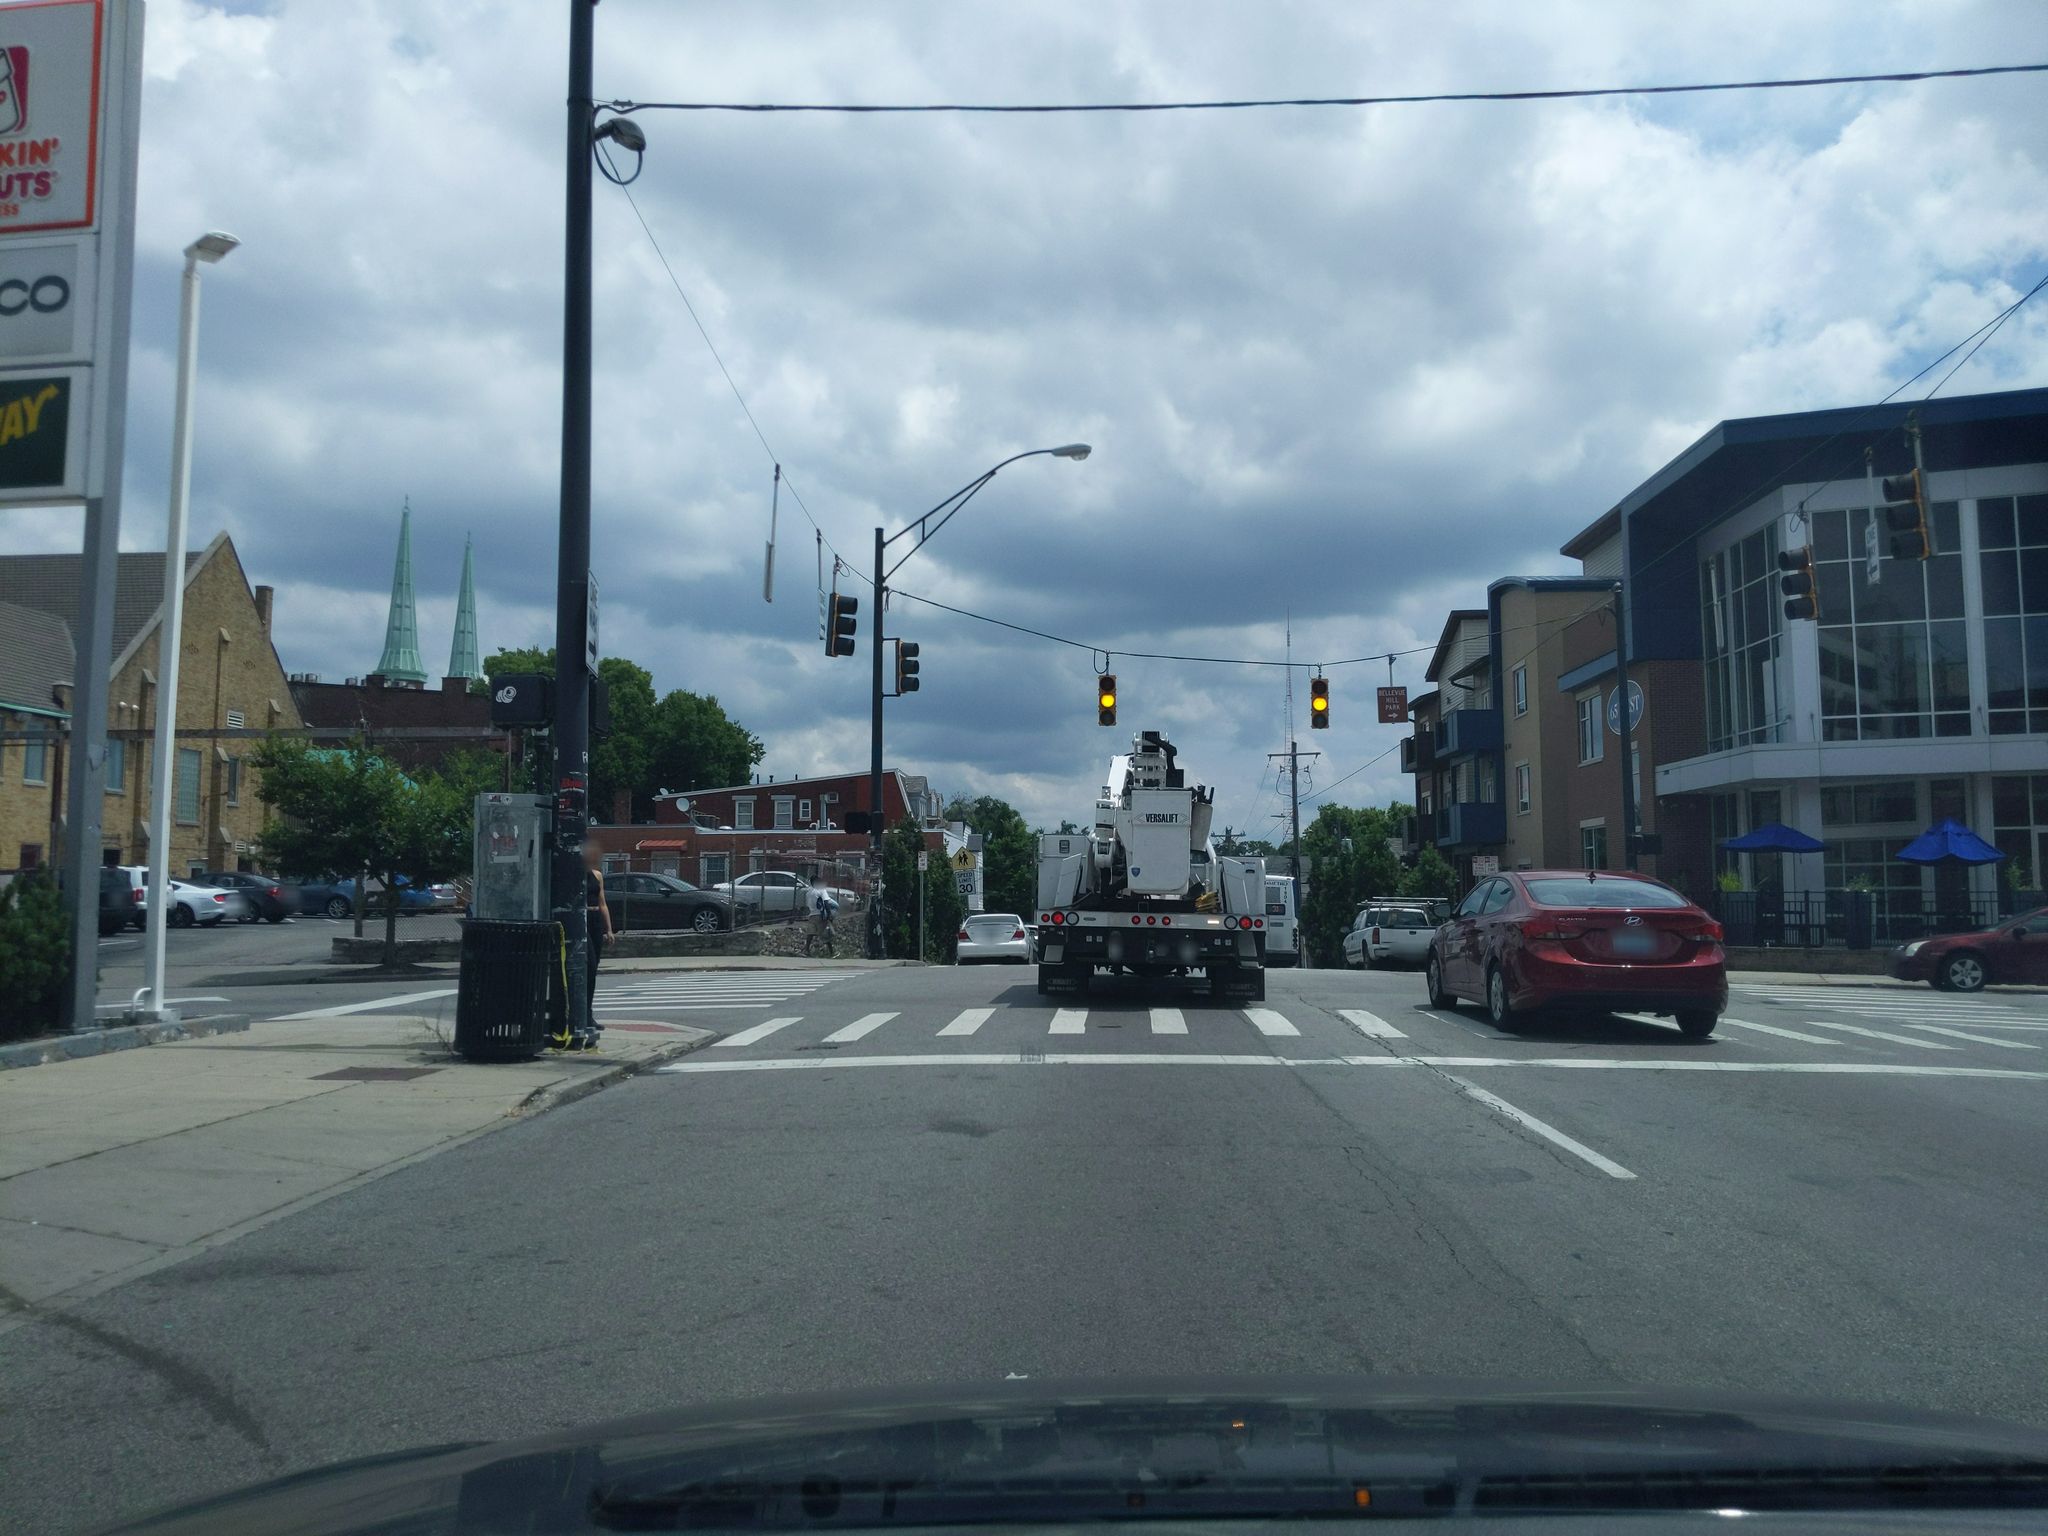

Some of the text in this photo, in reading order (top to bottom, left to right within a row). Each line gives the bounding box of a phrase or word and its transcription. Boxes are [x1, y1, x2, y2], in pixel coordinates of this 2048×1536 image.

[0, 275, 70, 316] CO
[0, 384, 59, 446] AY
[1145, 813, 1179, 823] VERSALIFT
[959, 883, 973, 894] 30
